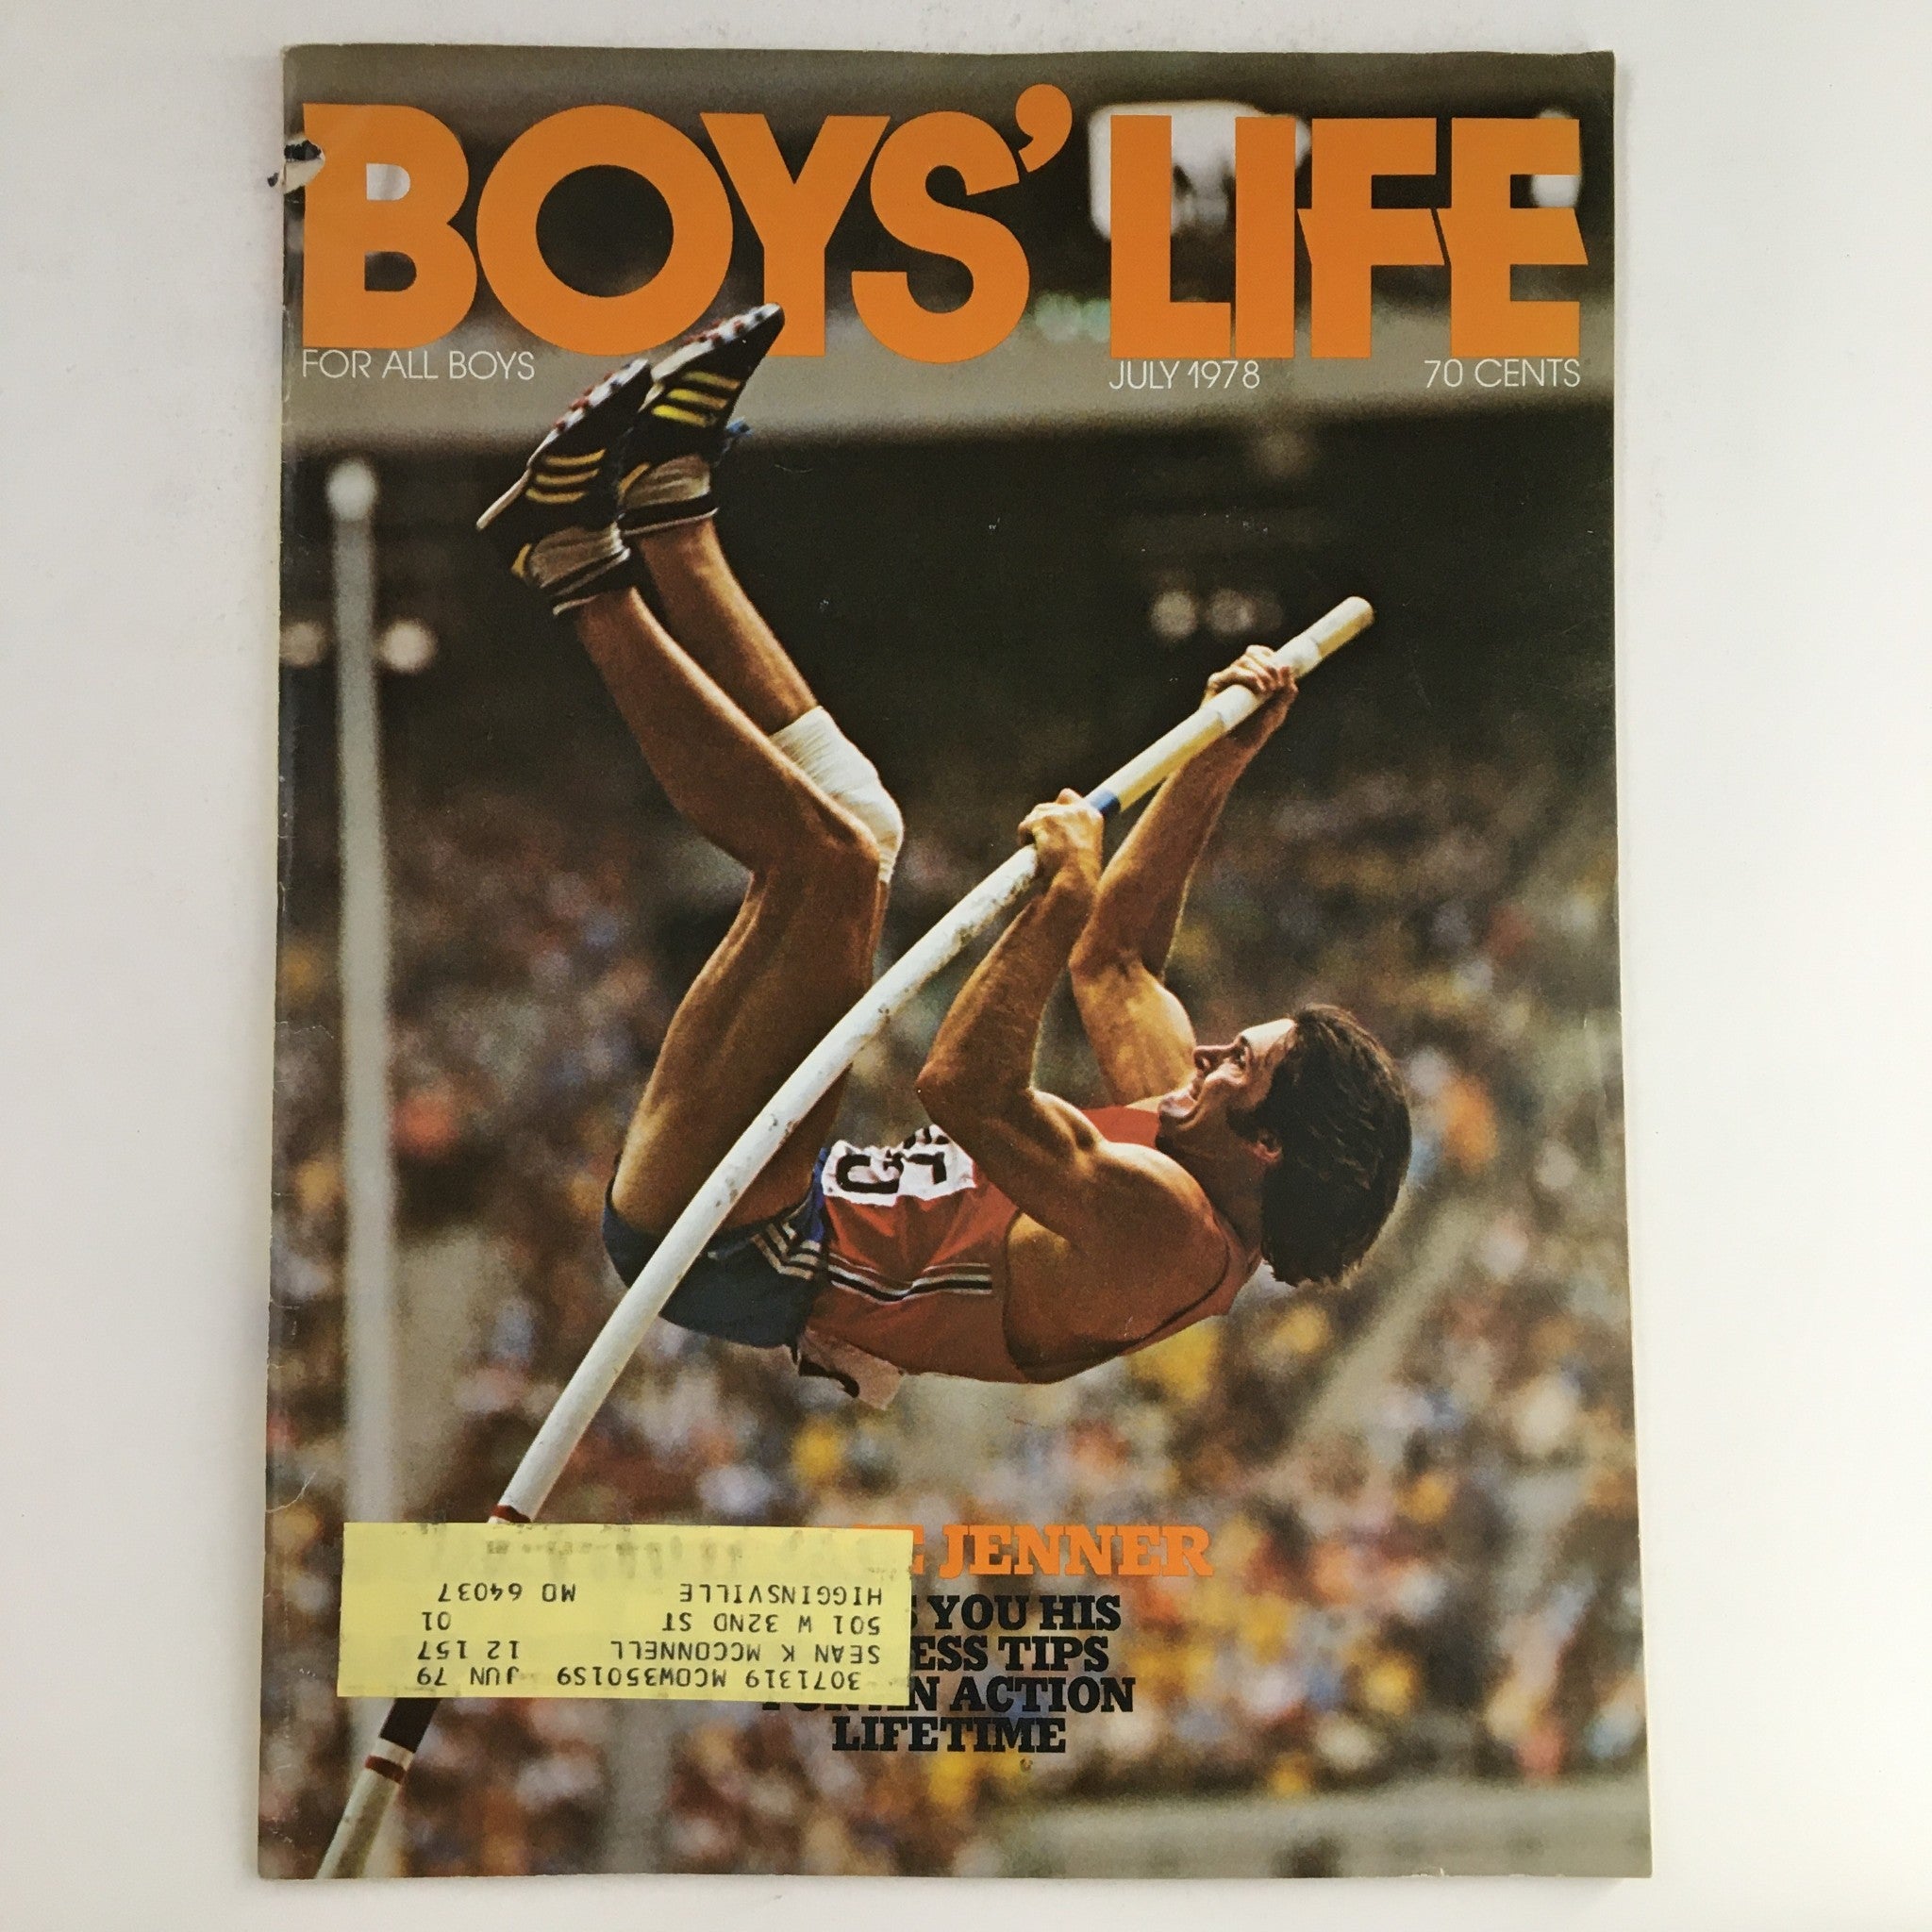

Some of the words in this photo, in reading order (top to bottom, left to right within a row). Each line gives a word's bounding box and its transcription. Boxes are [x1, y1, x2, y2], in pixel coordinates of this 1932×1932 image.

[1110, 114, 1589, 359] LIFE
[302, 349, 372, 378] FOR
[381, 350, 439, 378] ALL
[449, 350, 535, 380] BOYS
[1108, 360, 1180, 390] JULY
[1187, 360, 1260, 390] 1978
[1424, 358, 1463, 389] 70
[1474, 358, 1581, 388] CENTS
[939, 1524, 1214, 1579] JENNER
[437, 1582, 523, 1603] 64037
[541, 1583, 576, 1603] MO
[679, 1583, 883, 1607] HIGGINSVILLE
[422, 1610, 452, 1631] 01
[661, 1611, 693, 1633] ST
[713, 1612, 779, 1634] 32ND
[927, 1594, 1027, 1631] YOU
[1040, 1594, 1122, 1631] HIS
[798, 1614, 812, 1634] W
[833, 1614, 881, 1637] 501
[417, 1640, 467, 1660] 157
[487, 1640, 522, 1660] 12
[610, 1641, 761, 1663] MCCONNELL
[781, 1643, 796, 1663] K
[814, 1643, 881, 1665] SEAN
[998, 1636, 1109, 1672] TIPS
[416, 1666, 448, 1687] 79
[470, 1666, 520, 1686] JUN
[745, 1669, 862, 1691] 3071319
[949, 1675, 1136, 1713] ACTION
[832, 1716, 1067, 1754] LIFETIME
